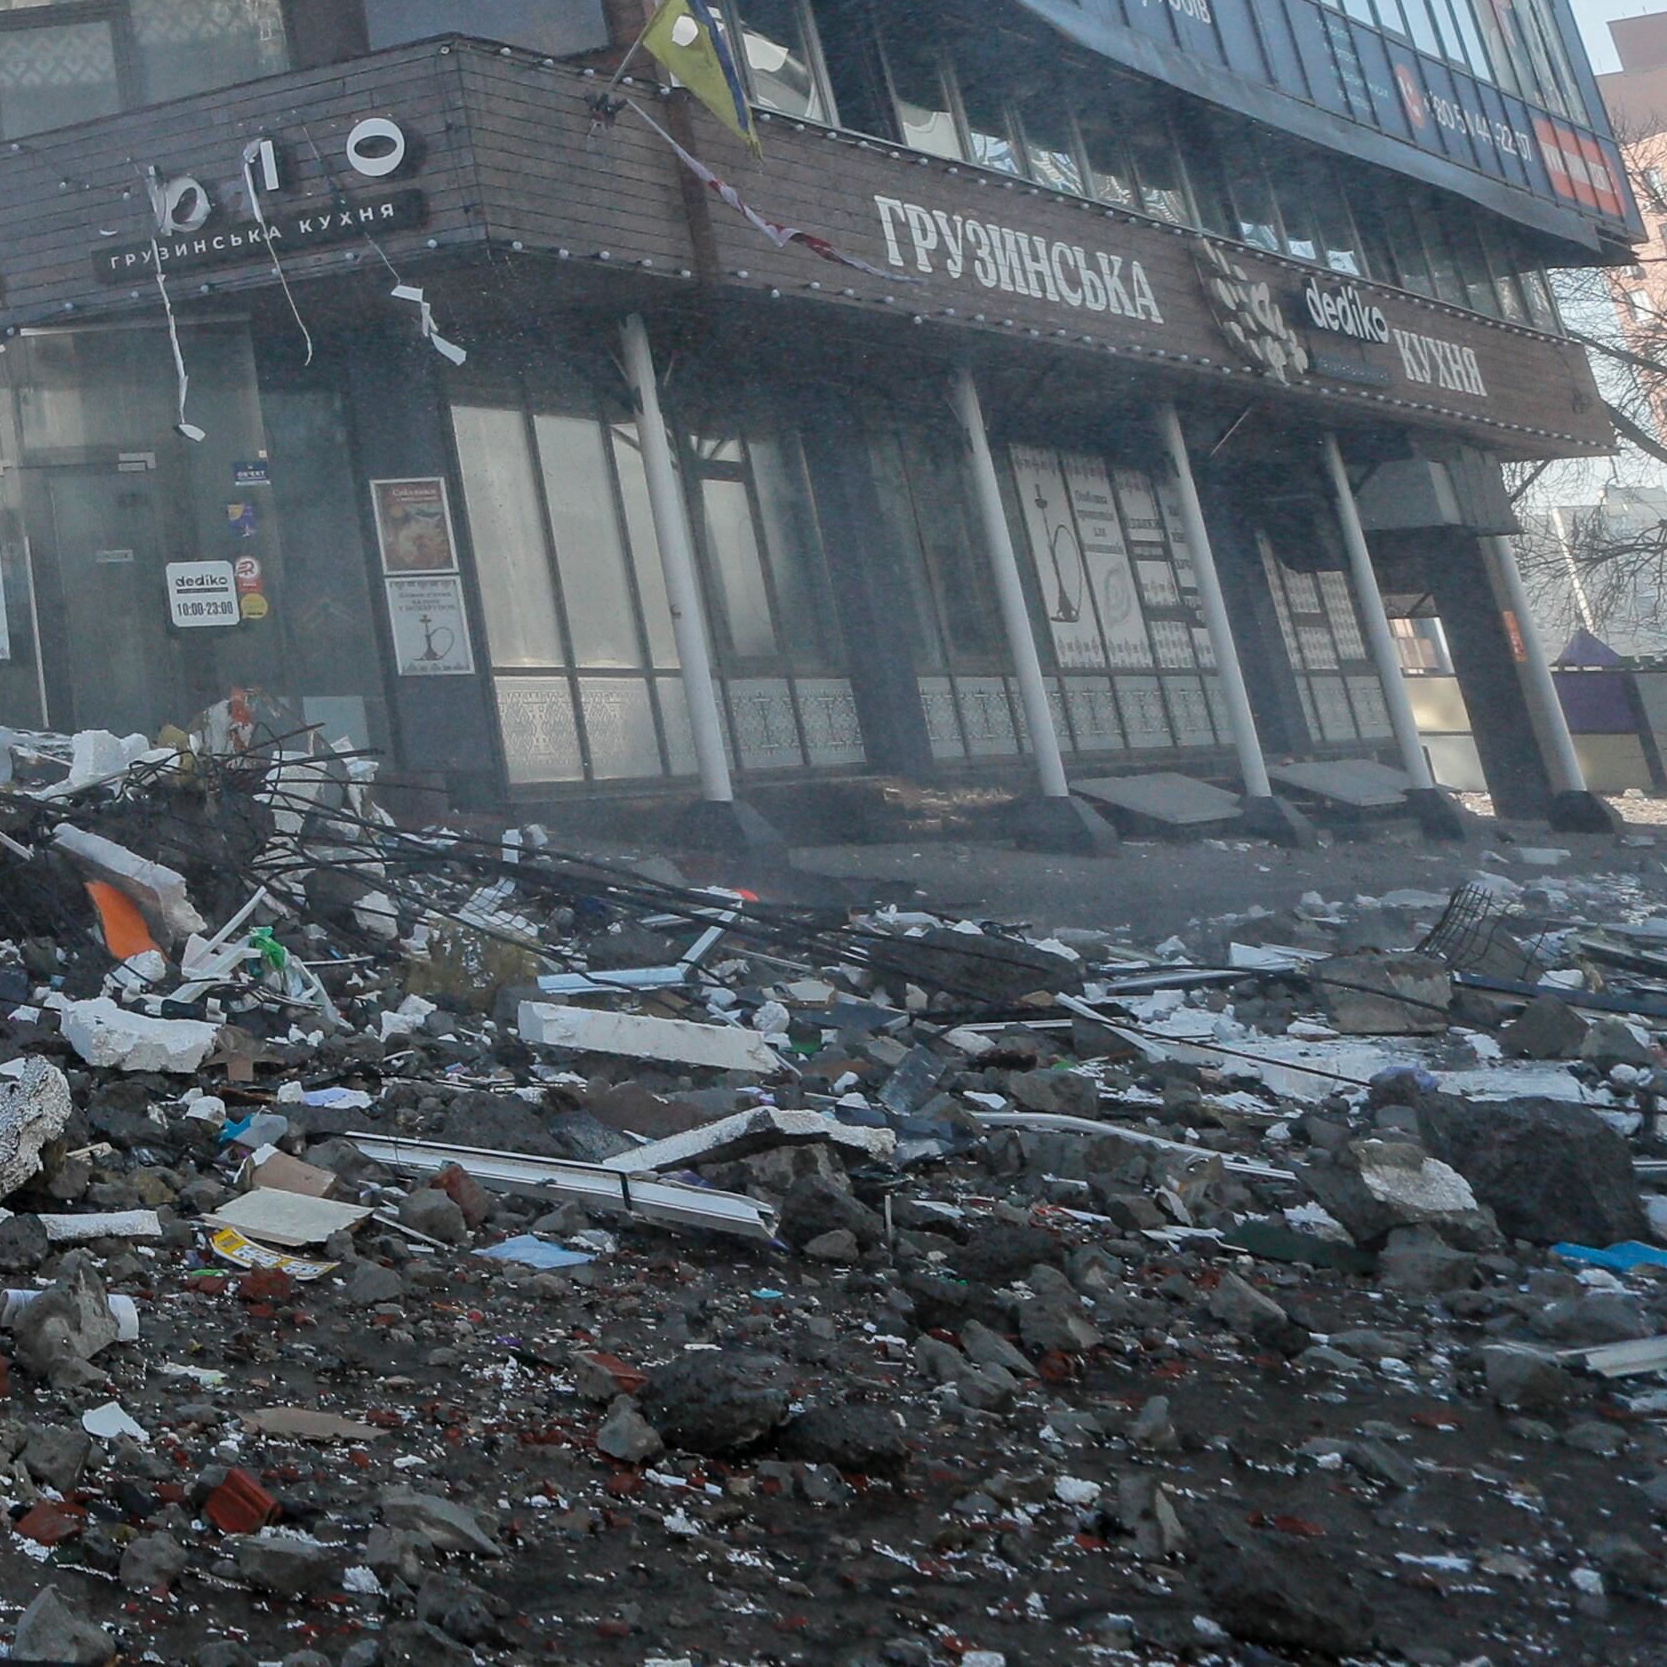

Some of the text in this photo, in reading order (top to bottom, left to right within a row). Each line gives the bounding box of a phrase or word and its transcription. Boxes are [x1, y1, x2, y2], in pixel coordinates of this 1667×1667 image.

[110, 204, 395, 269] ГРУЗИНСЬКА КУХНЯ
[874, 194, 1164, 324] ГРУЗИНСЬКА
[1305, 278, 1390, 344] dediko
[1394, 330, 1488, 397] КУХНЯ
[175, 575, 228, 588] dediko
[177, 601, 234, 617] 10:00-23:00
